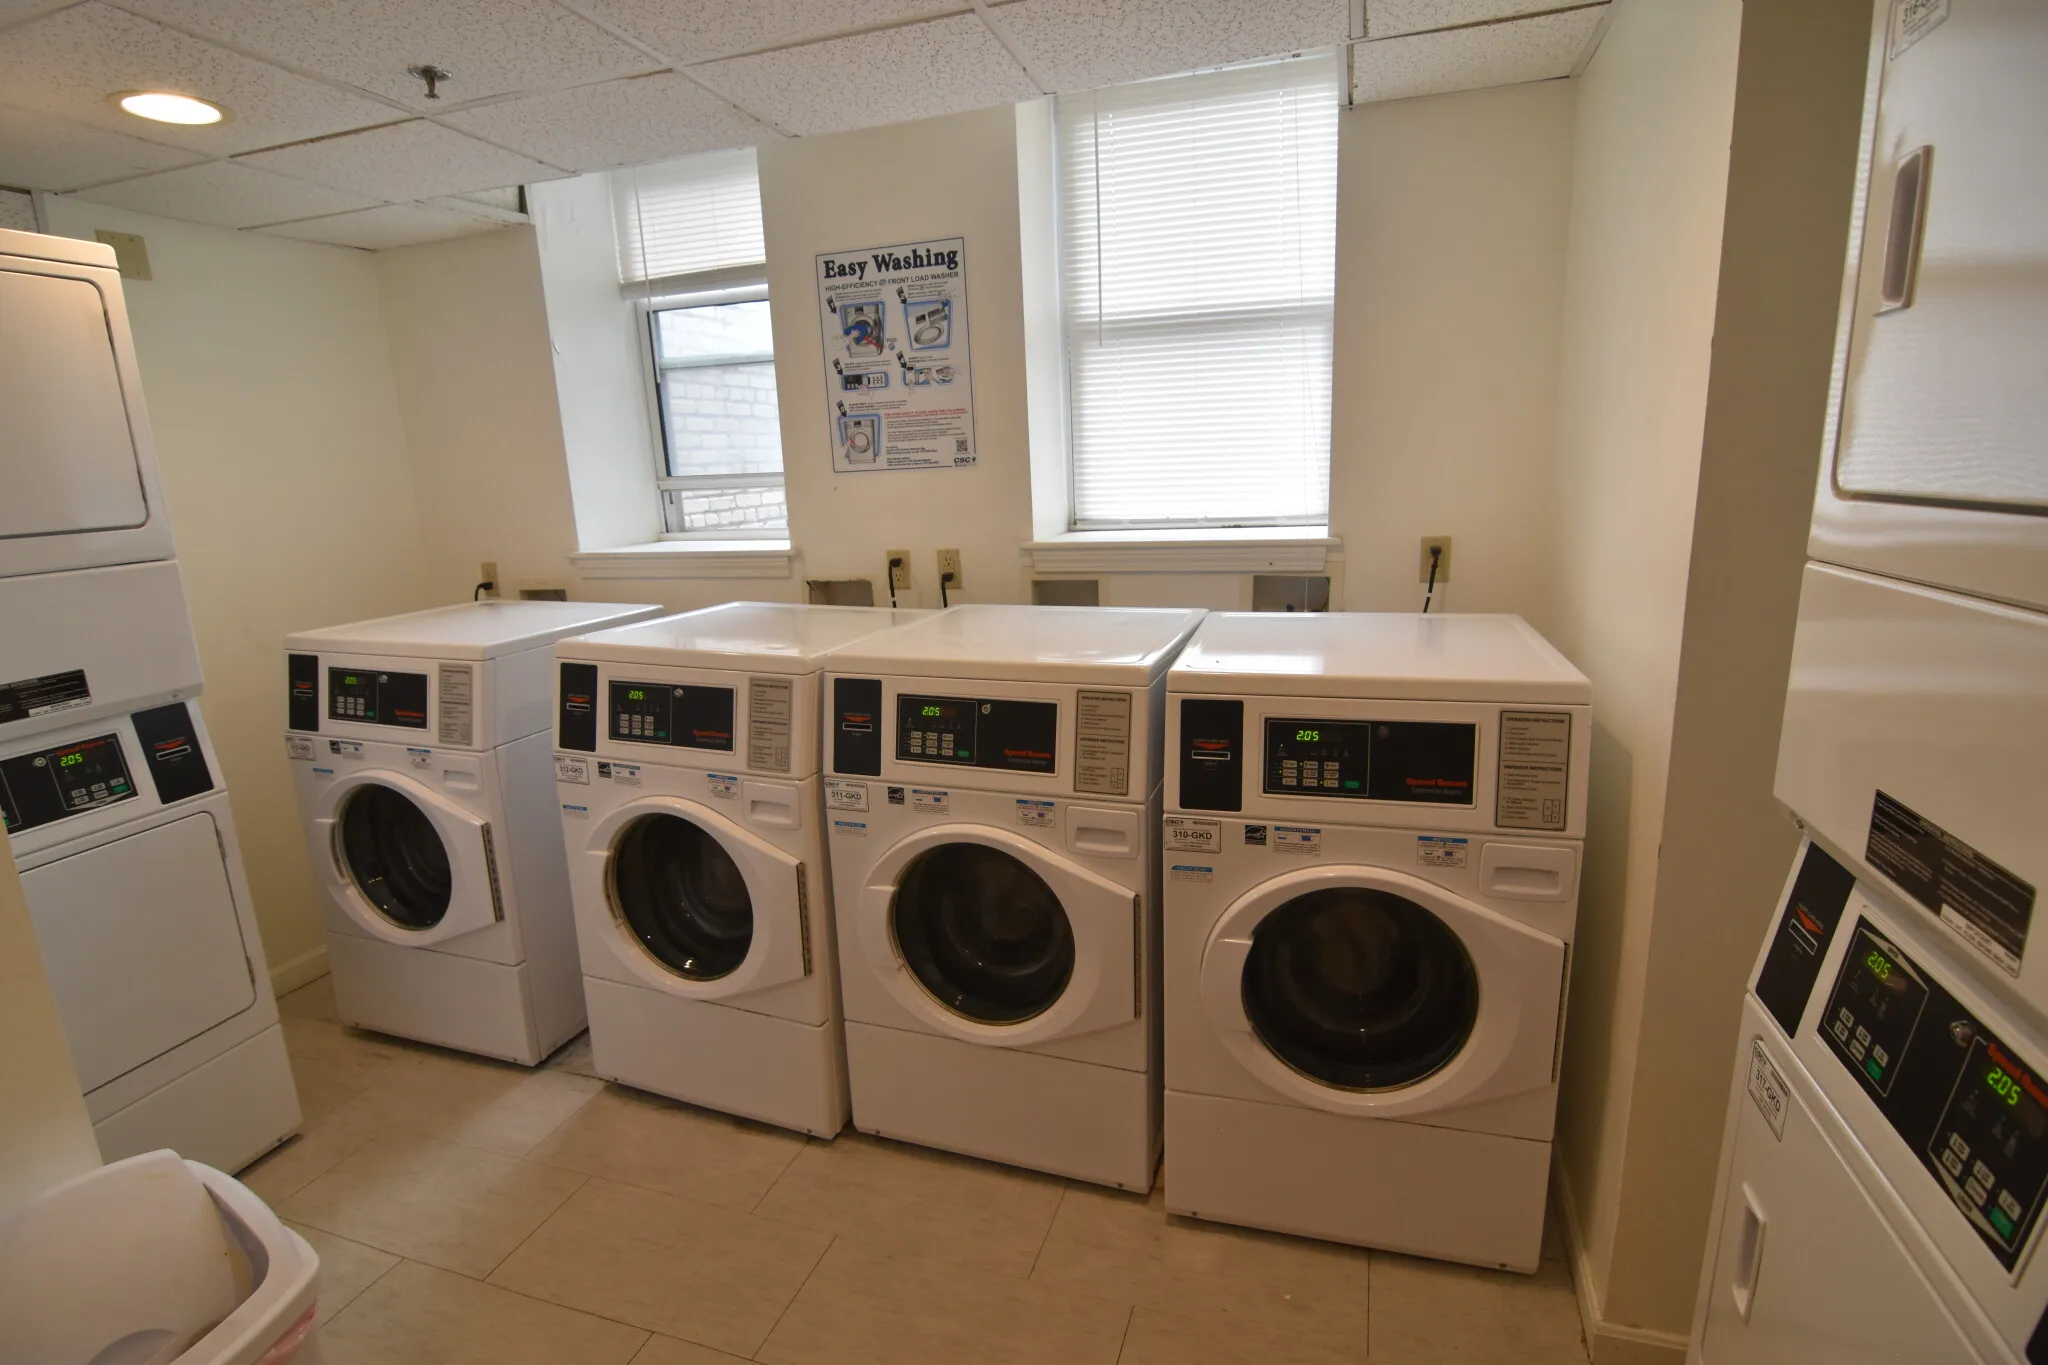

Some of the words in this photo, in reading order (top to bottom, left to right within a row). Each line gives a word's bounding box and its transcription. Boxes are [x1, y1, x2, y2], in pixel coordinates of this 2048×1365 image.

[823, 259, 868, 281] Easy
[872, 248, 959, 273] Washing
[825, 280, 878, 292] HIGH-EFFICIENCY
[888, 277, 909, 285] FRONT
[911, 274, 929, 283] LOAD
[930, 271, 959, 280] WASHER
[953, 456, 971, 464] CSC
[1296, 730, 1319, 741] 2.05
[60, 753, 83, 767] 2.05
[831, 791, 862, 800] 311-GKD
[1172, 830, 1213, 840] 310-GKD
[1867, 951, 1892, 981] 2.05
[1986, 1067, 2021, 1106] 2.05
